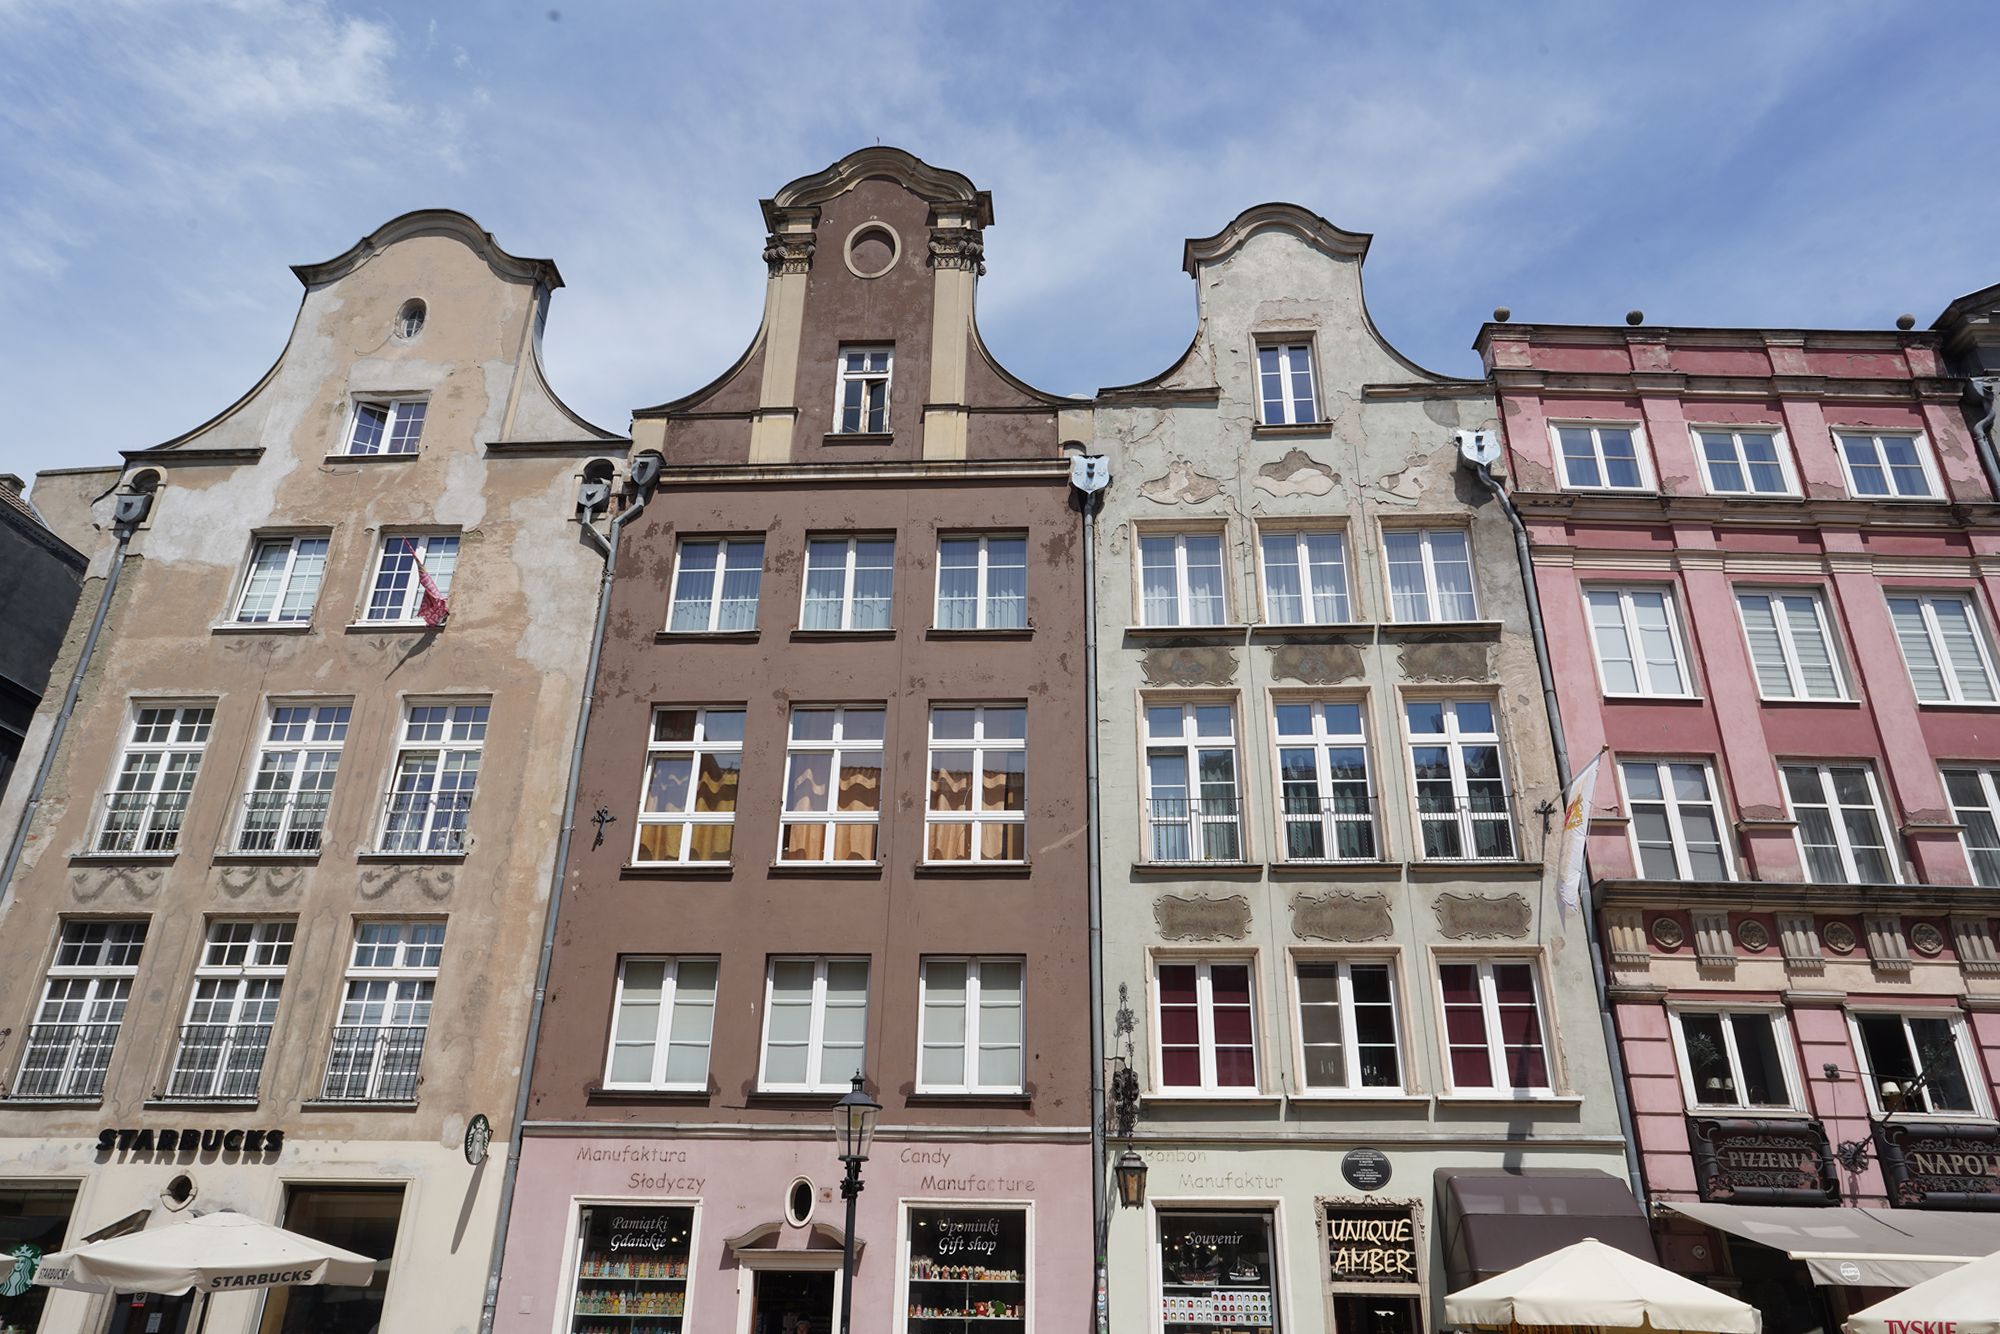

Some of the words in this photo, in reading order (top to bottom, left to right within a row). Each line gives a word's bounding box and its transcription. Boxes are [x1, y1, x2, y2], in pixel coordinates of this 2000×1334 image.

[95, 1128, 285, 1151] STARBUCKS
[577, 1145, 687, 1162] Manufaktura
[900, 1148, 951, 1168] Candy
[1144, 1147, 1207, 1163] Bonbon
[628, 1173, 706, 1194] Słodyczy
[920, 1174, 1036, 1192] Manufacture
[1178, 1171, 1284, 1190] Manufaktur
[612, 1216, 670, 1232] Pamiątki
[937, 1218, 1000, 1236] Upominki
[1331, 1218, 1412, 1246] UNIQUE
[610, 1233, 667, 1251] Gdańskie
[939, 1236, 965, 1255] Gift
[967, 1236, 997, 1255] shop
[1185, 1231, 1244, 1246] Souvenir
[1335, 1247, 1413, 1274] AMBER
[211, 1269, 314, 1288] STARBUCKS
[1884, 1319, 1958, 1334] TYSKIE
